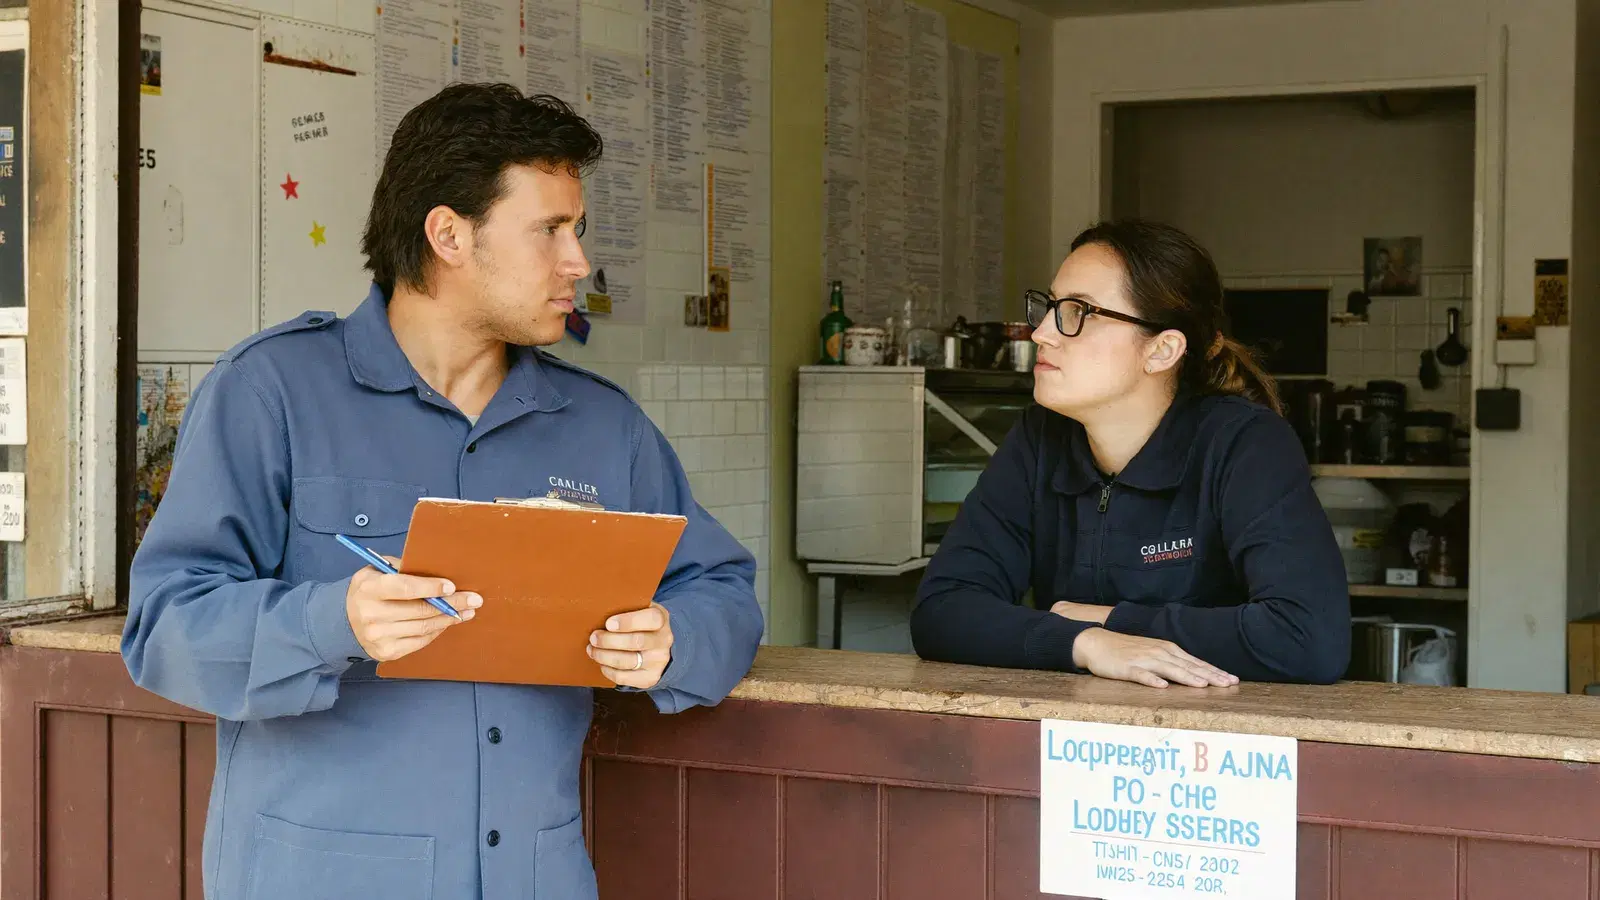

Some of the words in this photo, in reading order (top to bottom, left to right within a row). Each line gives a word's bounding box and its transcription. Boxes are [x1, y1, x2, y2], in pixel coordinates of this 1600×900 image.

[1193, 741, 1208, 772] B
[1218, 750, 1292, 780] AJNA
[1113, 775, 1145, 804] PO
[1166, 812, 1260, 847] SSERRS
